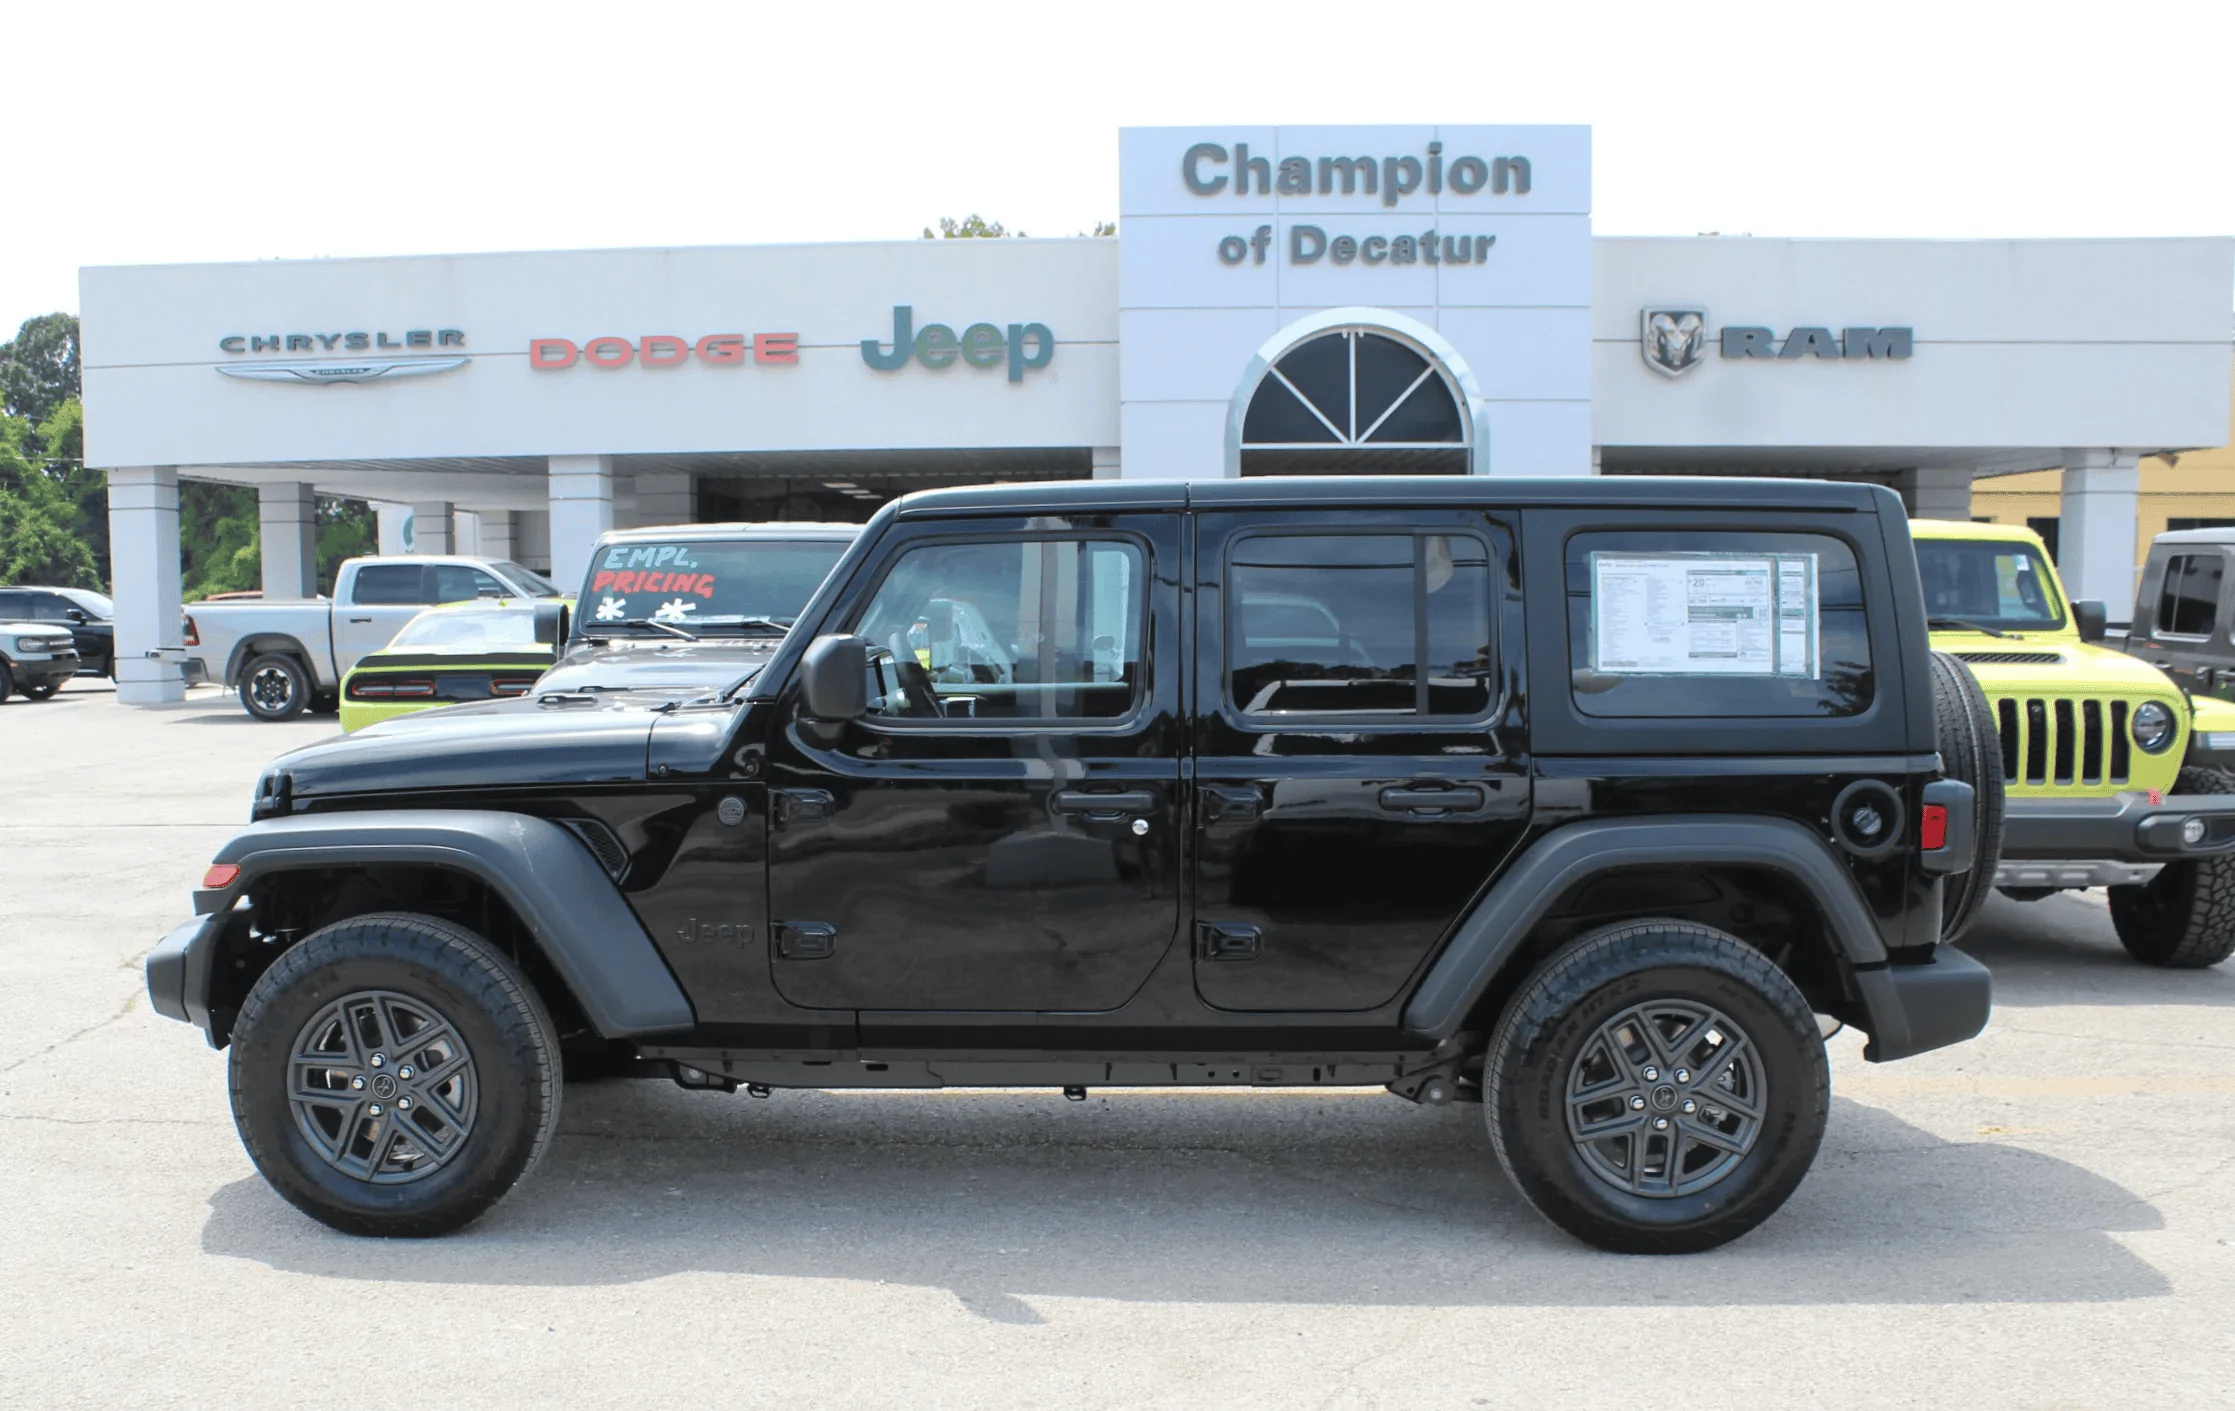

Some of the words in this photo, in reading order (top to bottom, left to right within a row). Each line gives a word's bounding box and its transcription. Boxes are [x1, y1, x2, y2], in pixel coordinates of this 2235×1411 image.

[1183, 142, 1532, 207] Champion
[1219, 225, 1271, 264] of
[1290, 225, 1495, 265] Decatur
[220, 329, 466, 353] CHRYSLER
[530, 333, 799, 369] DODGE
[860, 305, 1054, 382] Jeep
[1721, 327, 1913, 358] RAM
[592, 570, 715, 599] PRICING
[677, 918, 755, 951] Jeep
